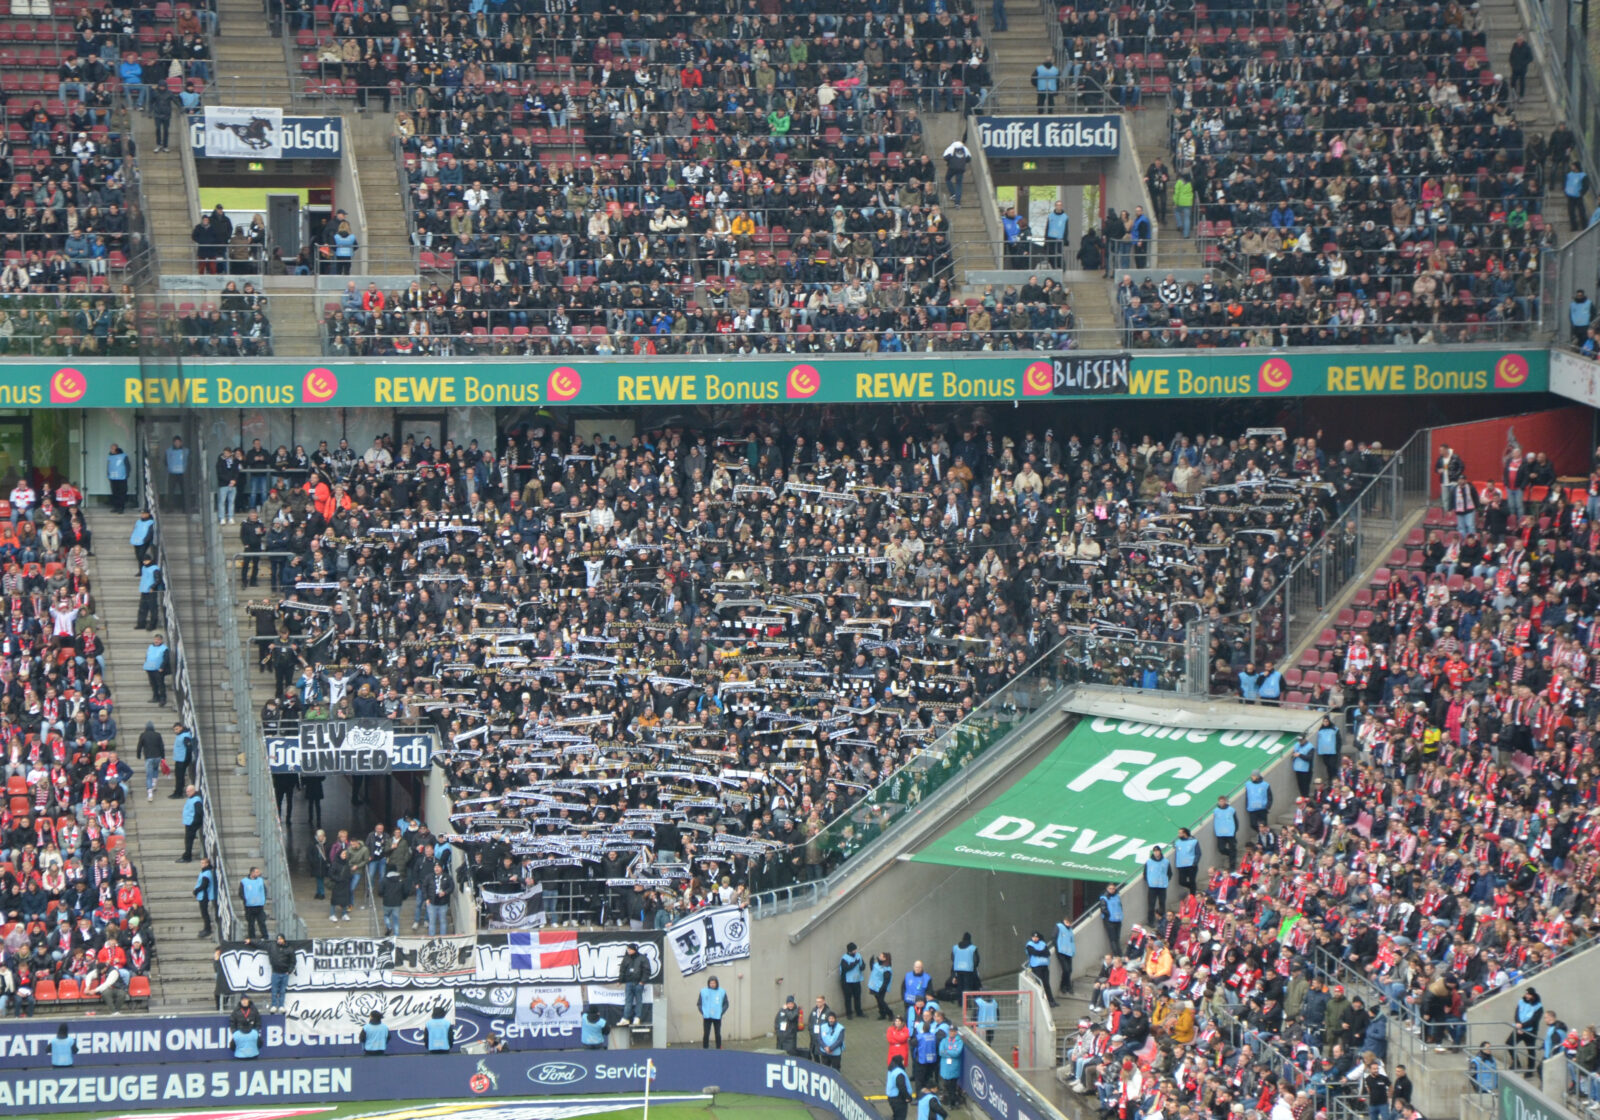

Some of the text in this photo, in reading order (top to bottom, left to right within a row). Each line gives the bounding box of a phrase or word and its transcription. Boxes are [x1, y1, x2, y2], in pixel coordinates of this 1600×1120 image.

[282, 122, 339, 152] ölsch
[979, 121, 1118, 150] Gaffel Kölsch
[125, 377, 294, 403] REWE Bonus
[375, 377, 539, 402] REWE Bonus
[618, 375, 778, 400] REWE Bonus
[856, 372, 1015, 398] REWE Bonus
[1129, 369, 1250, 395] WE Bonus
[1327, 365, 1487, 391] REWE Bonus
[301, 722, 347, 750] ELV
[301, 749, 388, 772] UNITED
[1066, 749, 1236, 807] FC!
[314, 956, 375, 971] KOLLEKTIV
[286, 1001, 344, 1028] Loyal
[389, 994, 454, 1018] Unity
[164, 1073, 206, 1099] AB
[211, 1071, 229, 1097] 5
[234, 1067, 352, 1096] JAHREN
[538, 1064, 577, 1082] Ford
[766, 1059, 808, 1094] FÜR
[988, 1084, 1008, 1119] Service
